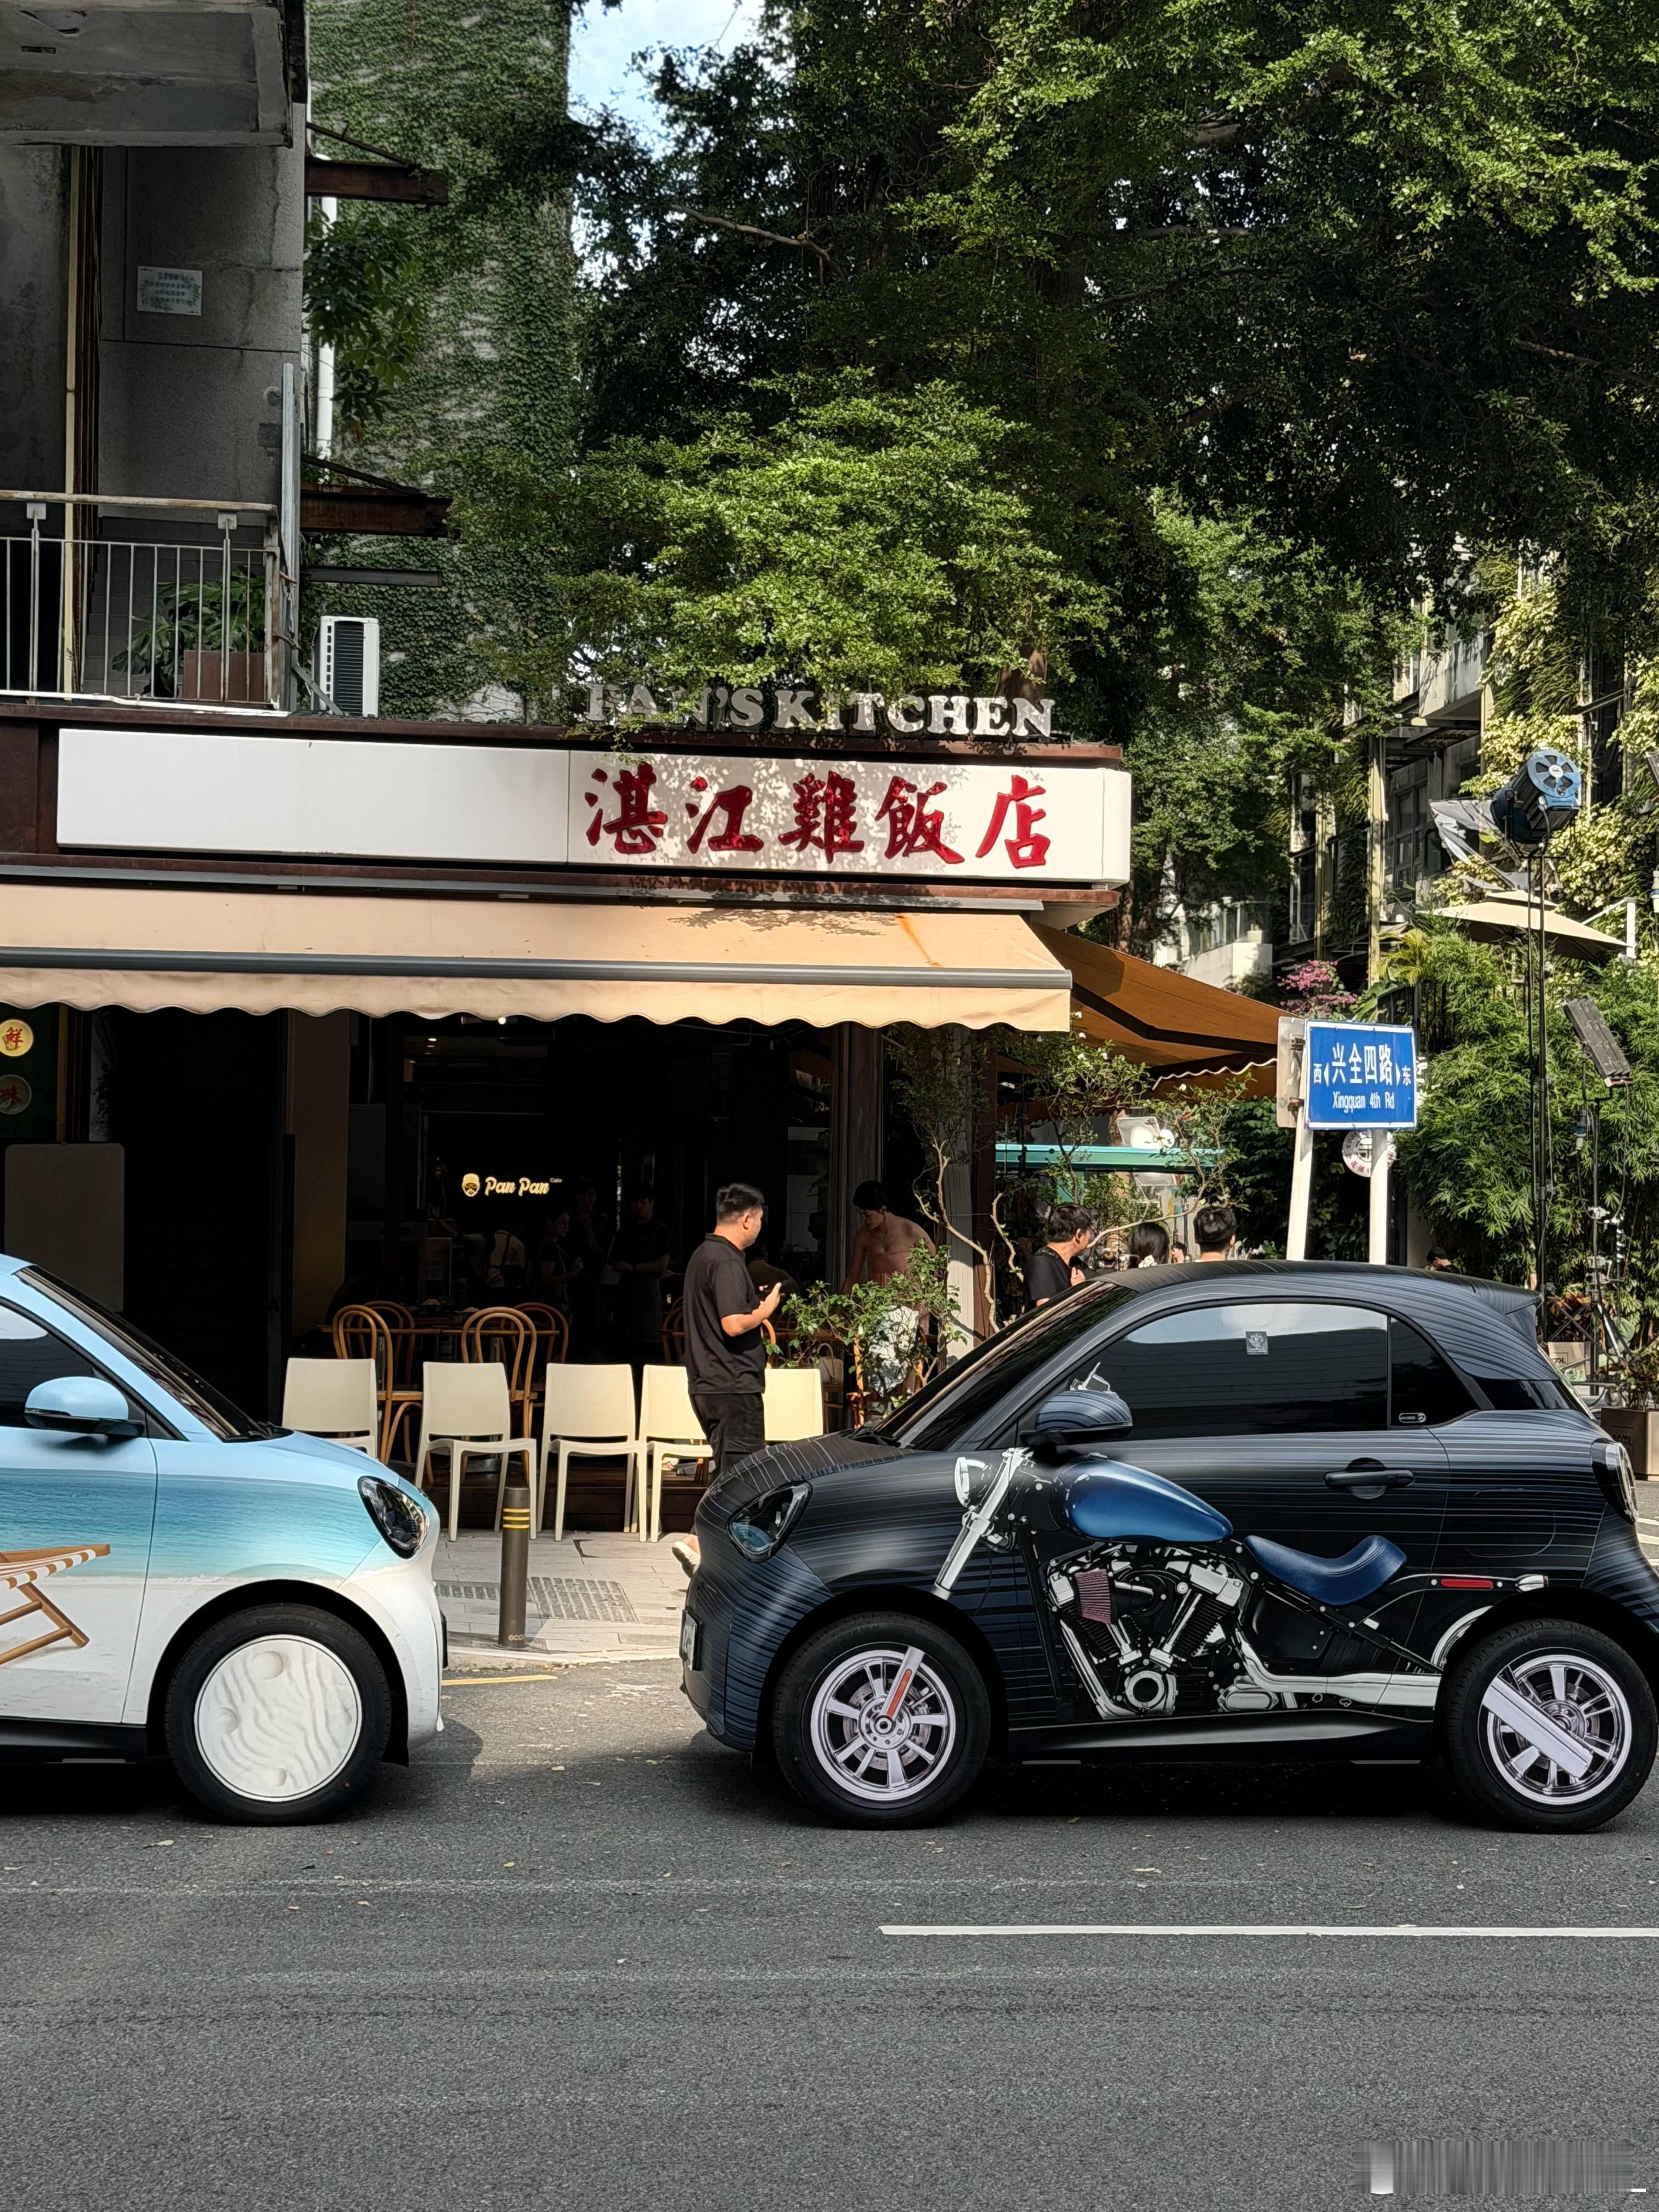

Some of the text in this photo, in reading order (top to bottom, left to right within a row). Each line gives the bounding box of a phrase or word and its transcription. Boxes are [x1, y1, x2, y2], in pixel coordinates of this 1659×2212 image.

[774, 690, 1056, 737] KITCHEN
[585, 763, 1051, 868] 湛江雞飯店
[1313, 1042, 1412, 1086] 西 兴全四路 东
[1332, 1092, 1395, 1114] Xingquan 4th Rd
[484, 1176, 516, 1197] Pan
[518, 1177, 550, 1197] Pan
